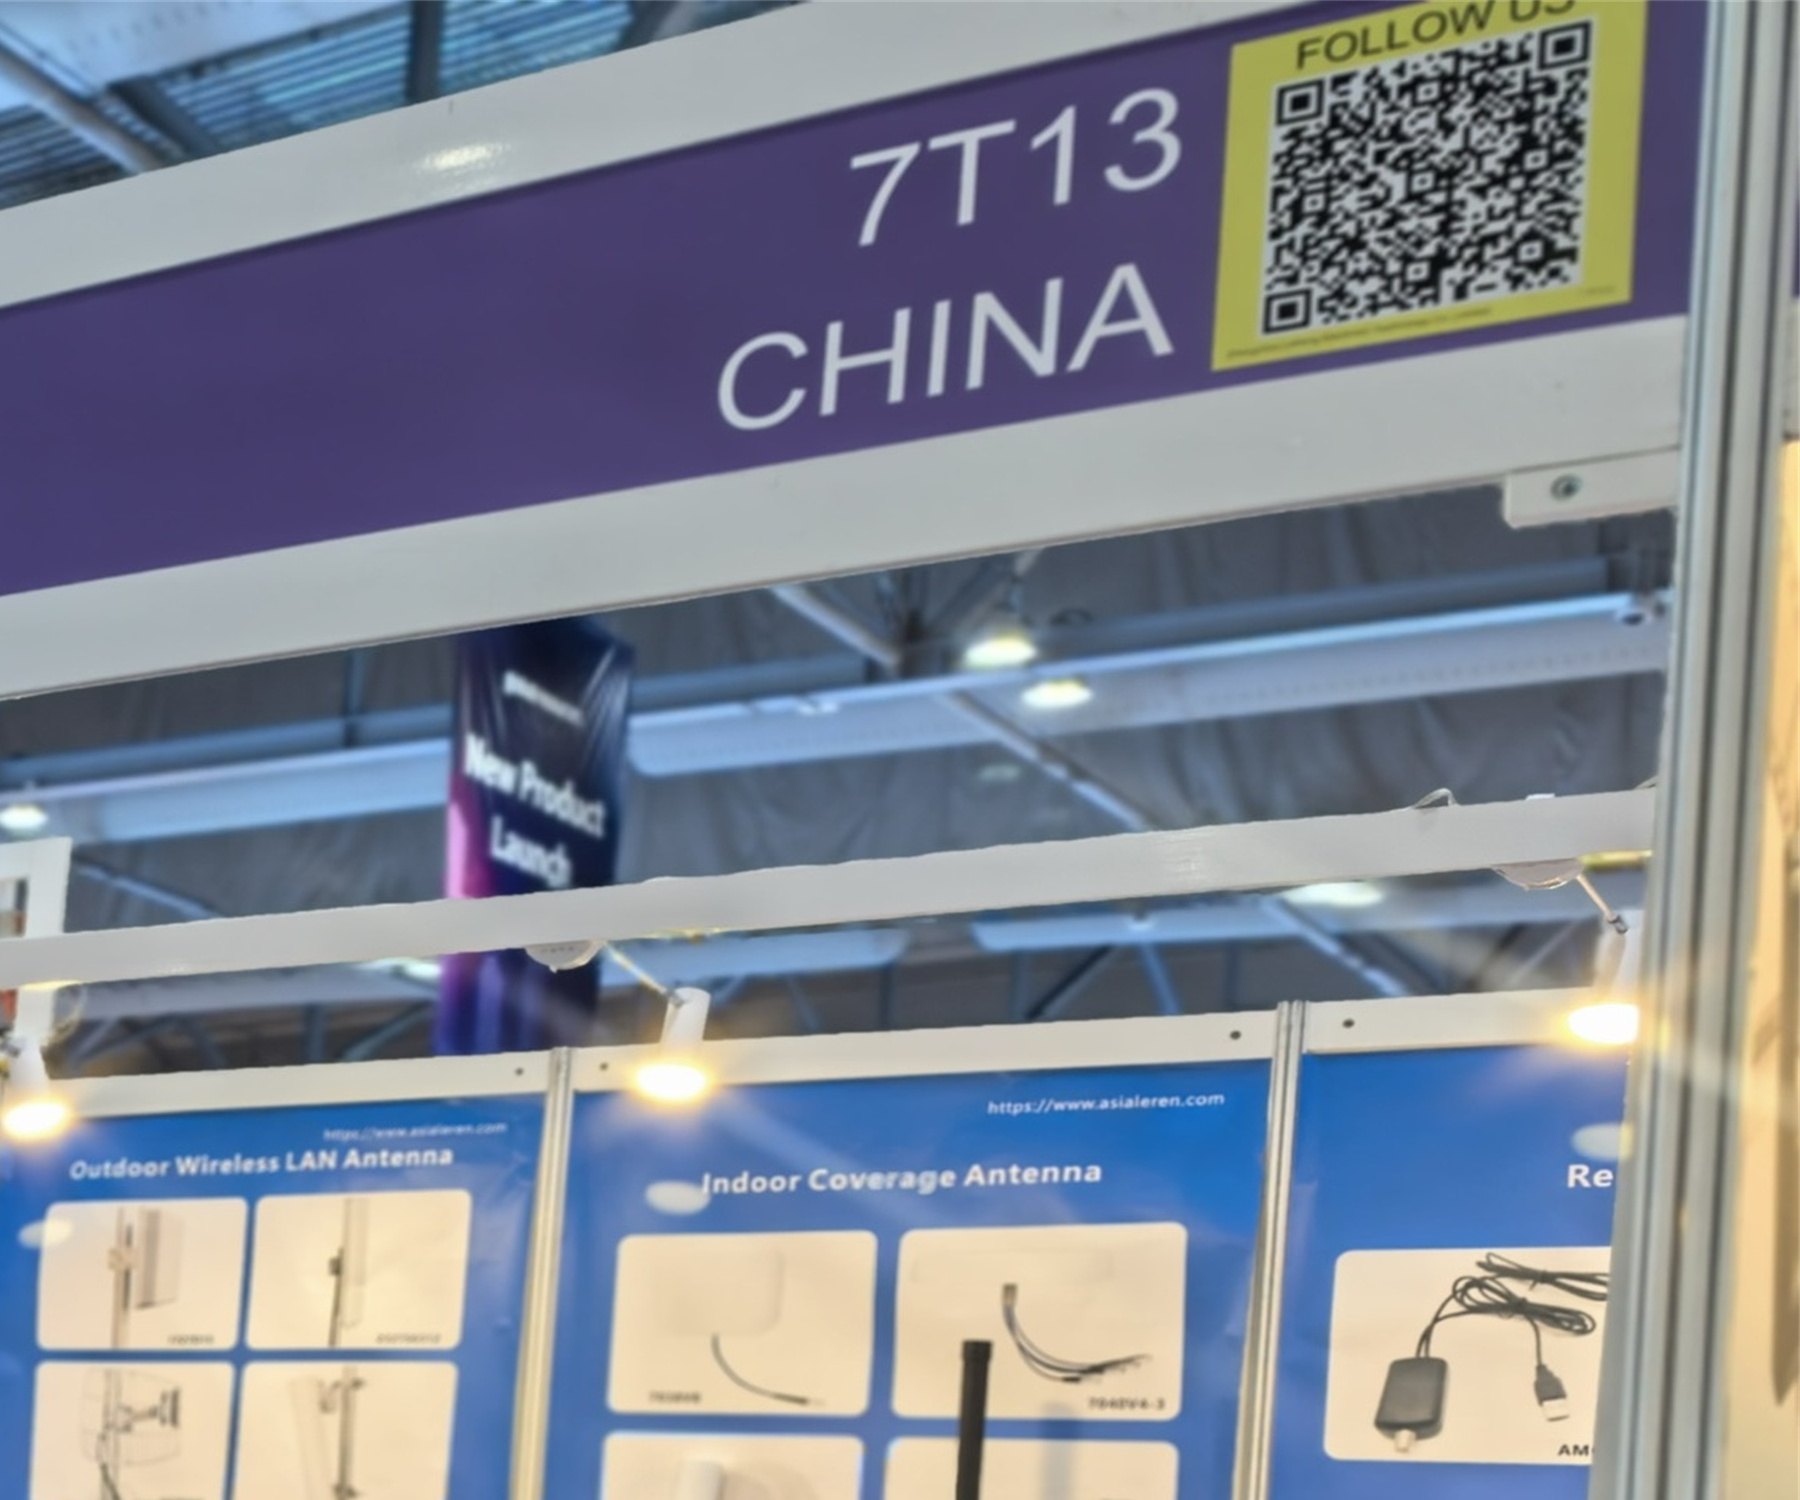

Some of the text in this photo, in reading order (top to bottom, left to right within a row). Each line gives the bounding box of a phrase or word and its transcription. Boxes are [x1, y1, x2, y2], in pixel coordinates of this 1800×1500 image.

[1296, 0, 1495, 70] FOLLOW
[849, 87, 1182, 247] 7T13
[717, 262, 1174, 431] CHINA
[987, 1094, 1224, 1115] https://www.asialeren.com
[70, 1148, 452, 1179] Outdoor Wireless LAN Antenna
[1567, 1164, 1614, 1188] Re
[701, 1164, 1101, 1195] Indoor Coverage Antenna
[1557, 1445, 1596, 1457] AM
